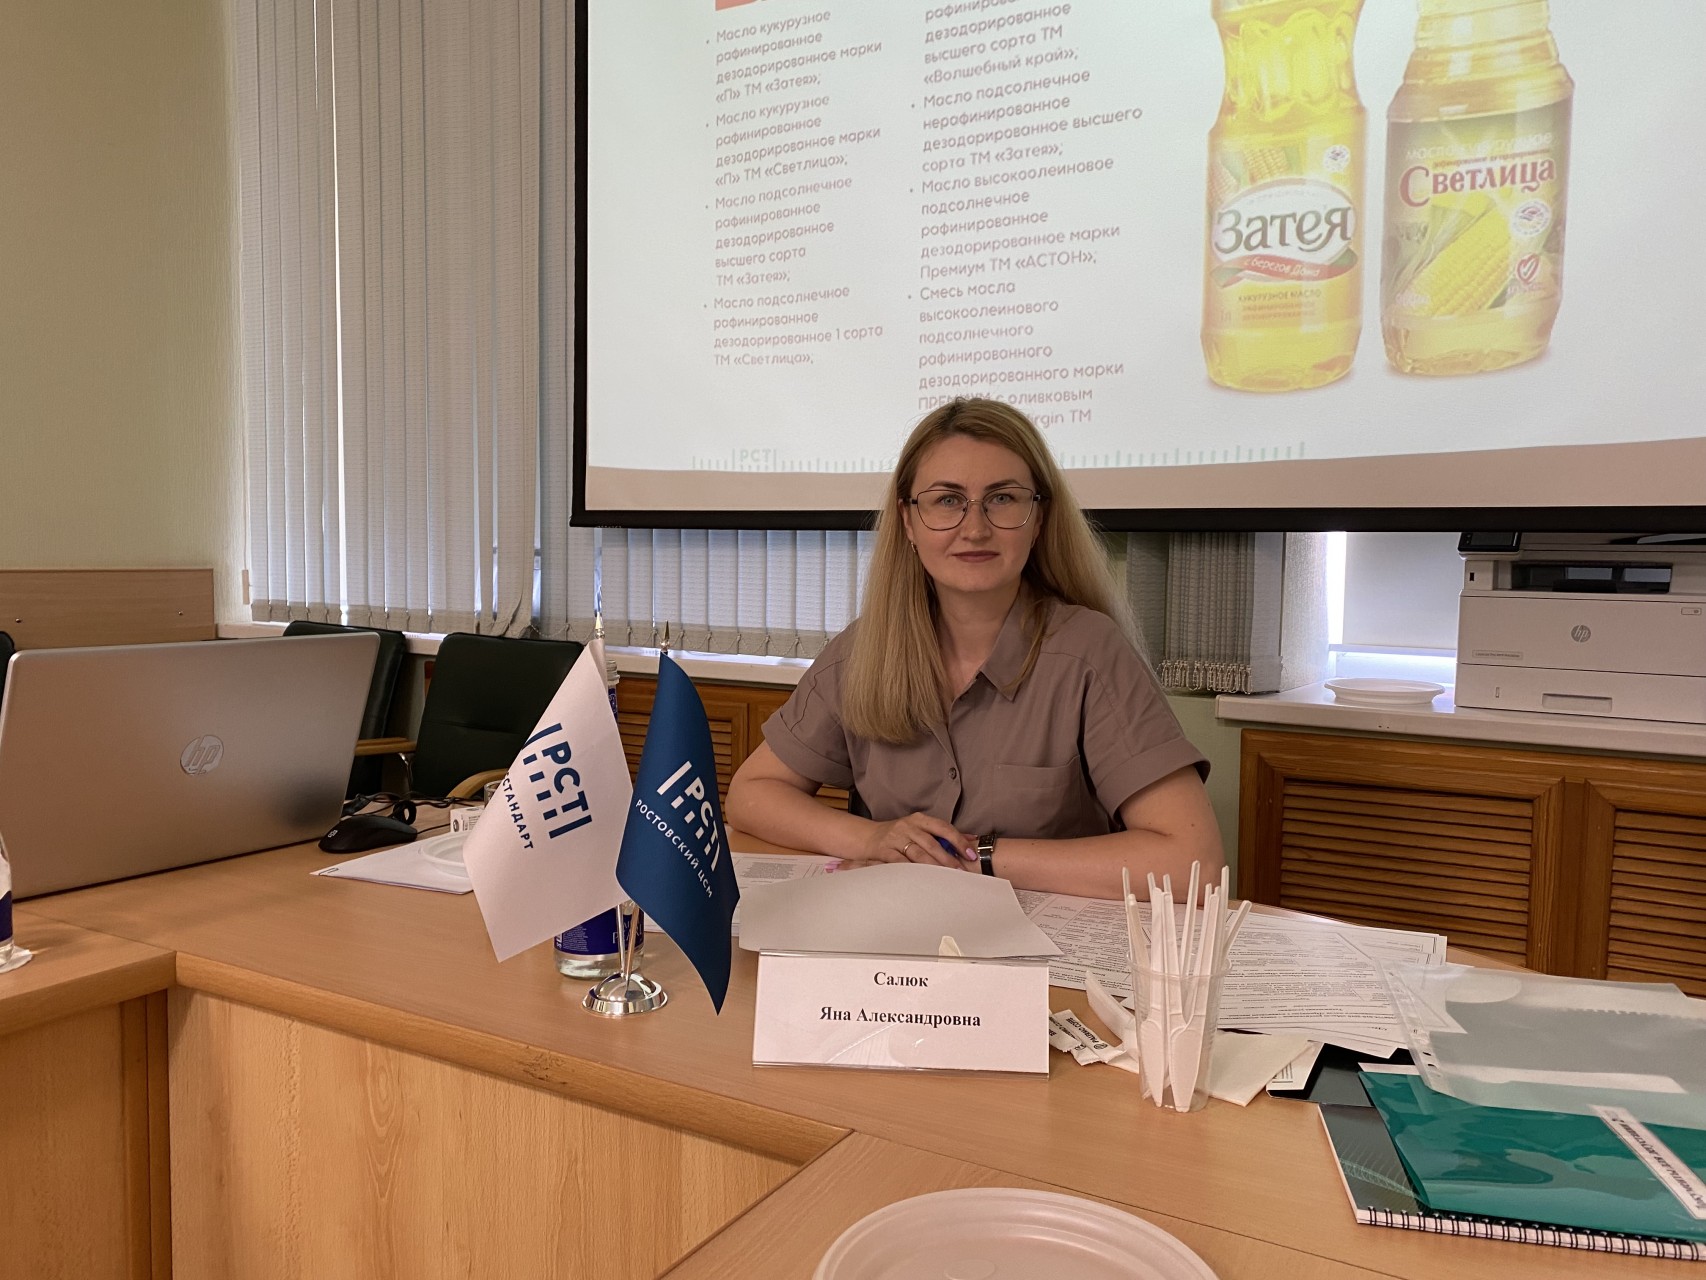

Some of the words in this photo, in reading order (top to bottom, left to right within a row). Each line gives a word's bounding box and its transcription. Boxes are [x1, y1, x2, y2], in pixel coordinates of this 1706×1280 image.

[716, 25, 757, 43] Масло
[759, 10, 831, 34] кукурузное
[924, 0, 1018, 23] рафиниров
[924, 3, 1072, 44] дезодорированное
[716, 32, 823, 65] рафинированное
[924, 42, 986, 64] высшего
[990, 32, 1036, 53] сорта
[1040, 24, 1063, 41] ТМ
[716, 51, 836, 85] дезодорированное
[840, 40, 882, 60] марки
[924, 54, 1022, 85] «Волшебный
[716, 89, 741, 103] «П»
[744, 82, 762, 96] ТМ
[923, 91, 973, 109] Масло
[976, 70, 1091, 99] подсолнечное
[716, 111, 756, 127] Масло
[759, 95, 830, 118] кукурузное
[923, 96, 1070, 130] нерафинированное
[715, 117, 822, 149] рафинированное
[923, 120, 1068, 152] дезодорированное
[1072, 107, 1143, 130] высшего
[715, 135, 835, 168] дезодорированное
[839, 128, 881, 145] марки
[922, 156, 965, 174] сорта
[970, 150, 991, 165] ТМ
[995, 142, 1063, 163] «Затея»;
[715, 172, 740, 187] «П»
[744, 168, 761, 182] ТМ
[922, 176, 970, 194] Масло
[974, 157, 1114, 188] высокоолеиновое
[1399, 159, 1556, 208] Светлица
[715, 194, 756, 209] Масло
[758, 177, 852, 201] подсолнечное
[921, 191, 1030, 216] подсолнечное
[715, 203, 821, 231] рафинированное
[921, 211, 1049, 239] рафинированное
[1214, 206, 1352, 254] Затея
[715, 222, 834, 250] дезодорированное
[921, 232, 1065, 259] дезодорированное
[1069, 225, 1120, 242] марки
[715, 253, 766, 268] высшего
[769, 247, 806, 263] сорта
[920, 262, 986, 281] Премиум
[990, 258, 1011, 271] ТМ
[716, 274, 733, 287] ТМ
[920, 287, 963, 301] Смесь
[967, 281, 1016, 297] масла
[714, 297, 754, 310] Масло
[757, 286, 850, 307] подсолнечное
[919, 300, 1059, 322] высокоолеинового
[713, 312, 819, 332] рафинированное
[714, 331, 832, 349] дезодорированное
[835, 328, 841, 341] 1
[843, 325, 883, 341] сорта
[919, 324, 1034, 344] подсолнечного
[714, 354, 730, 366] ТМ
[918, 345, 1053, 369] рафинированного
[919, 367, 1069, 390] дезодорированного
[1073, 362, 1124, 380] марки
[1008, 389, 1093, 405] оливковым
[182, 736, 222, 775] hp
[541, 740, 589, 813] РСТ
[503, 772, 534, 849] СТАНДАРТ
[684, 776, 718, 845] РСТ
[636, 799, 699, 869] РОСТОВСКИЙ
[697, 869, 713, 898] ЦСМ
[873, 971, 929, 988] Салюк
[820, 1006, 851, 1021] Яна
[856, 1008, 981, 1029] Александровна
